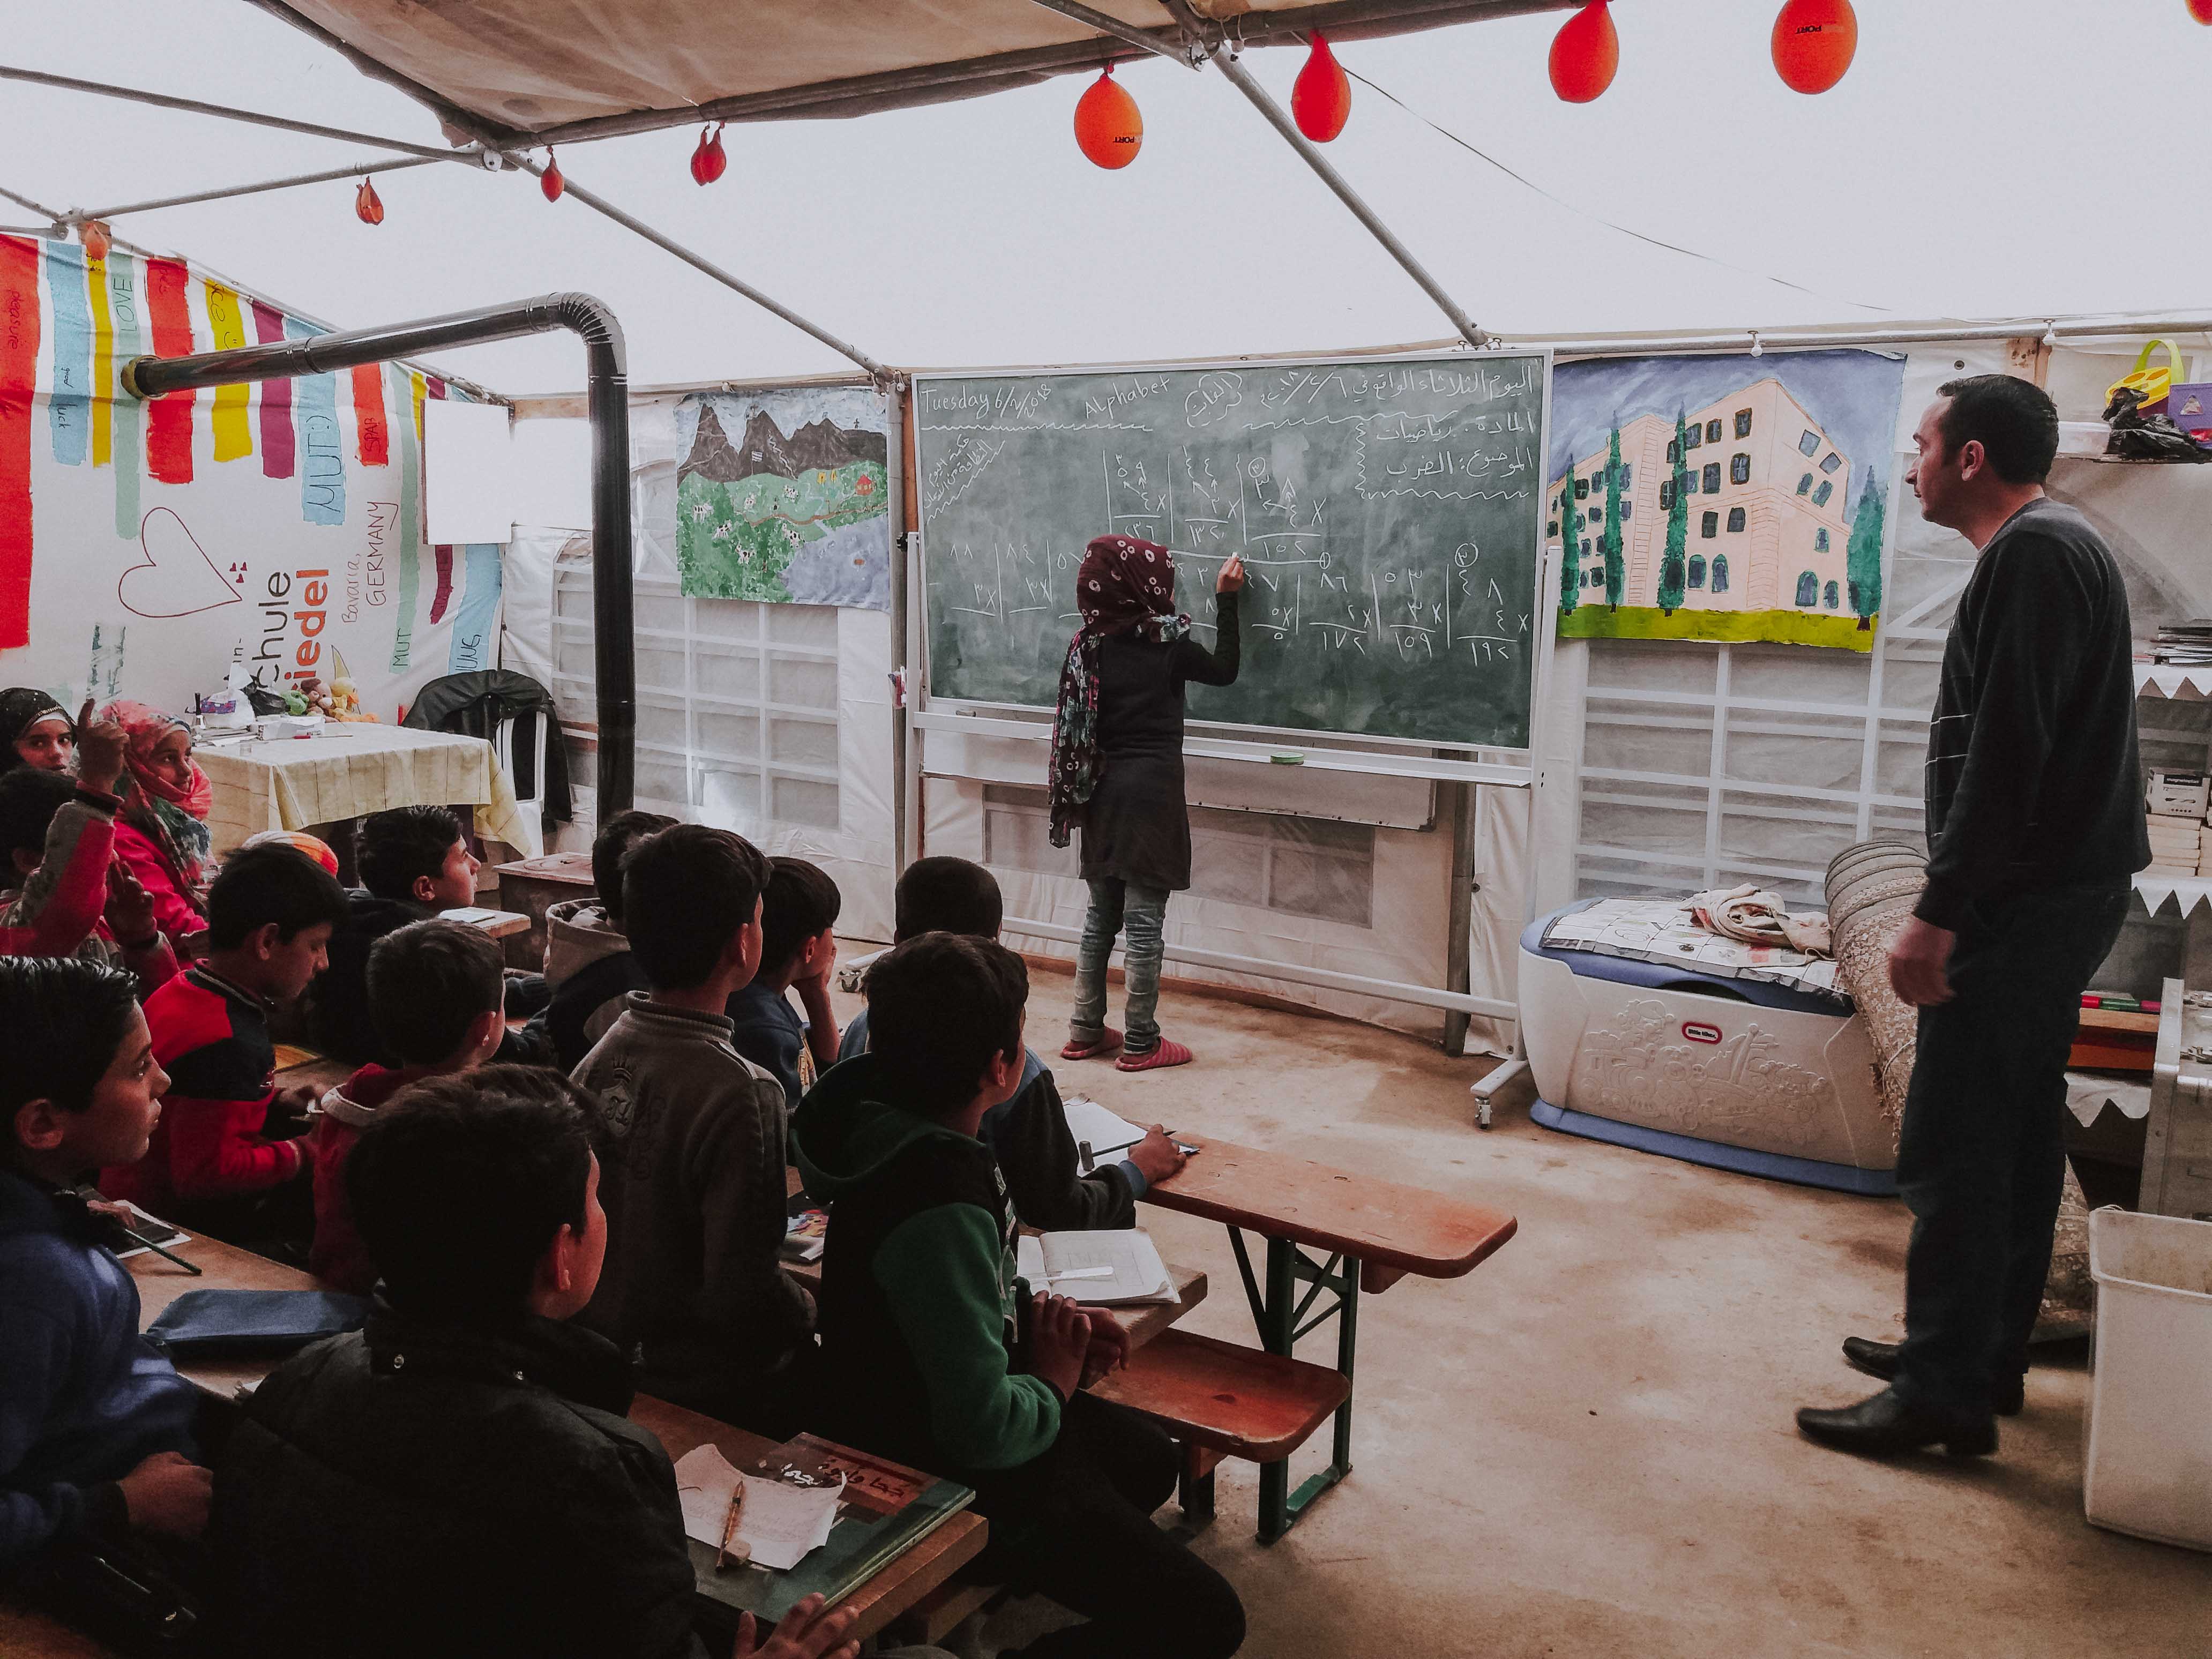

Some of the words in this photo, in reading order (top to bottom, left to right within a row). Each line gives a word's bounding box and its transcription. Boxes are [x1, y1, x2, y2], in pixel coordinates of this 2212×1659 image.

[114, 278, 137, 331] LOVE
[1352, 373, 1368, 402] في
[1372, 369, 1415, 401] الواقع
[1489, 365, 1533, 401] اليوم
[56, 403, 78, 429] luck
[920, 385, 989, 420] Tuesday
[1386, 450, 1453, 483] الضرب
[366, 502, 399, 606] GERMANY
[285, 569, 328, 690] iedel
[393, 627, 412, 666] MUT
